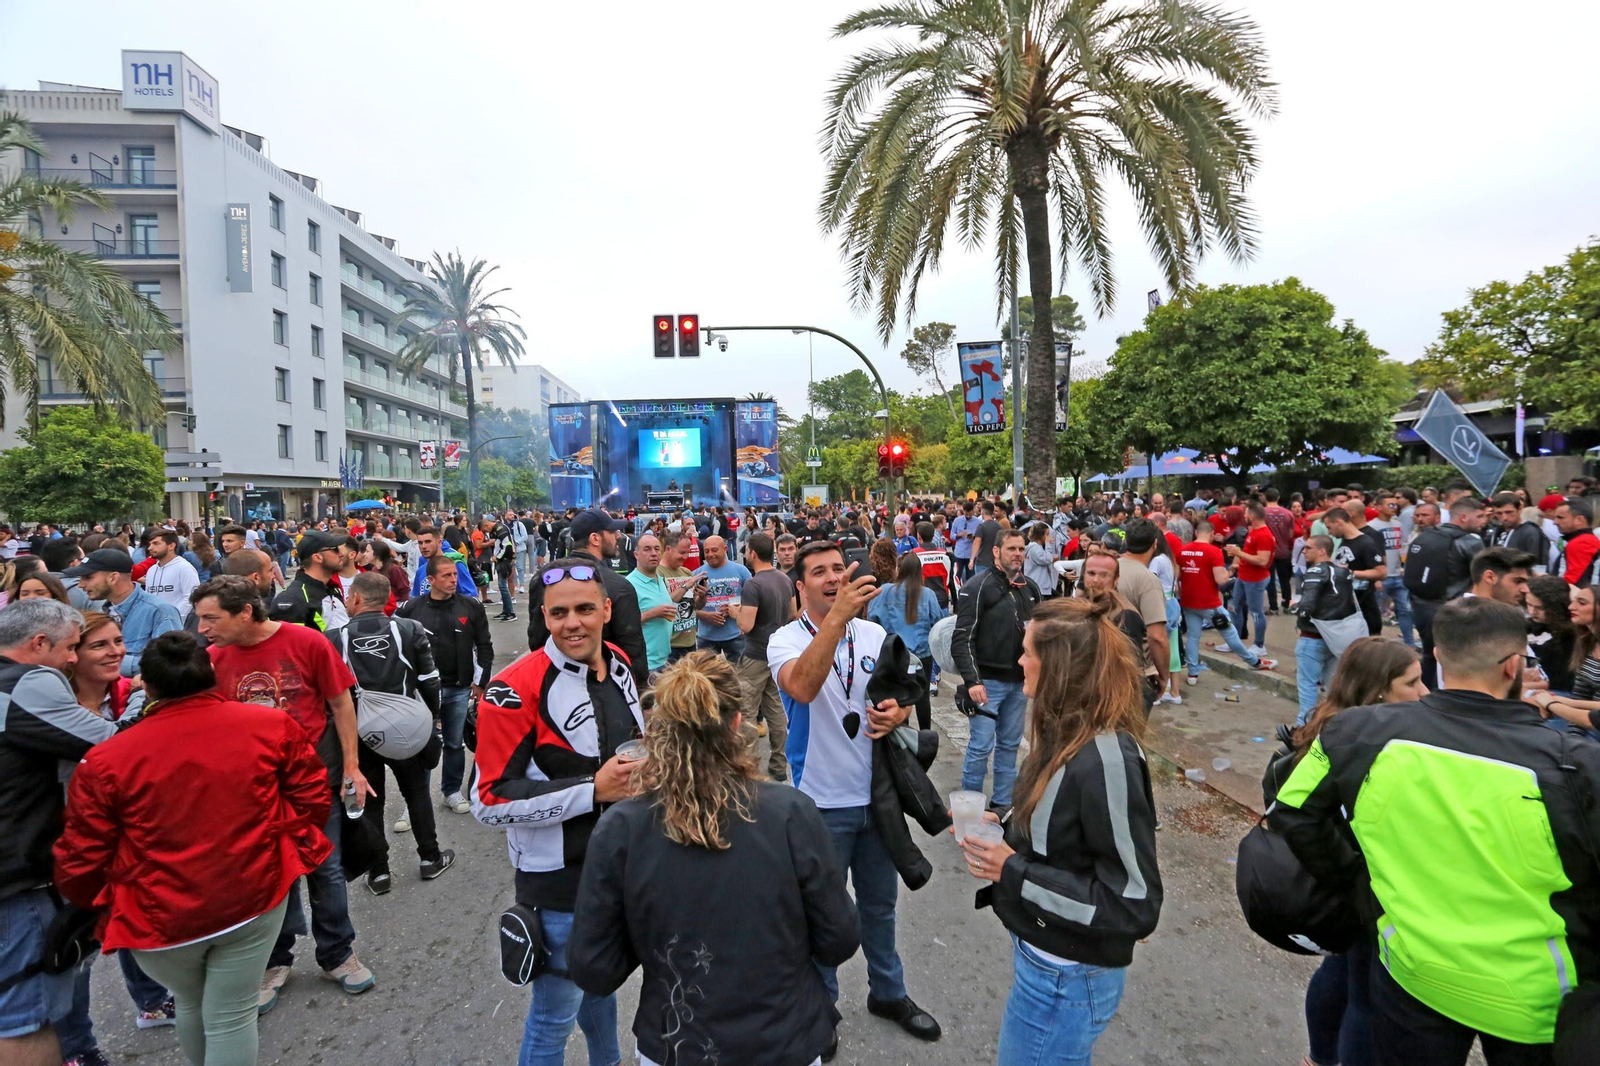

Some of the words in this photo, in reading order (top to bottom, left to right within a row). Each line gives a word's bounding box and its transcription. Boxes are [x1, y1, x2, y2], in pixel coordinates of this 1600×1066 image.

[135, 88, 174, 96] HOTELS
[189, 95, 214, 118] HOTELS
[986, 422, 1005, 431] PEPE
[674, 620, 692, 631] NEVER
